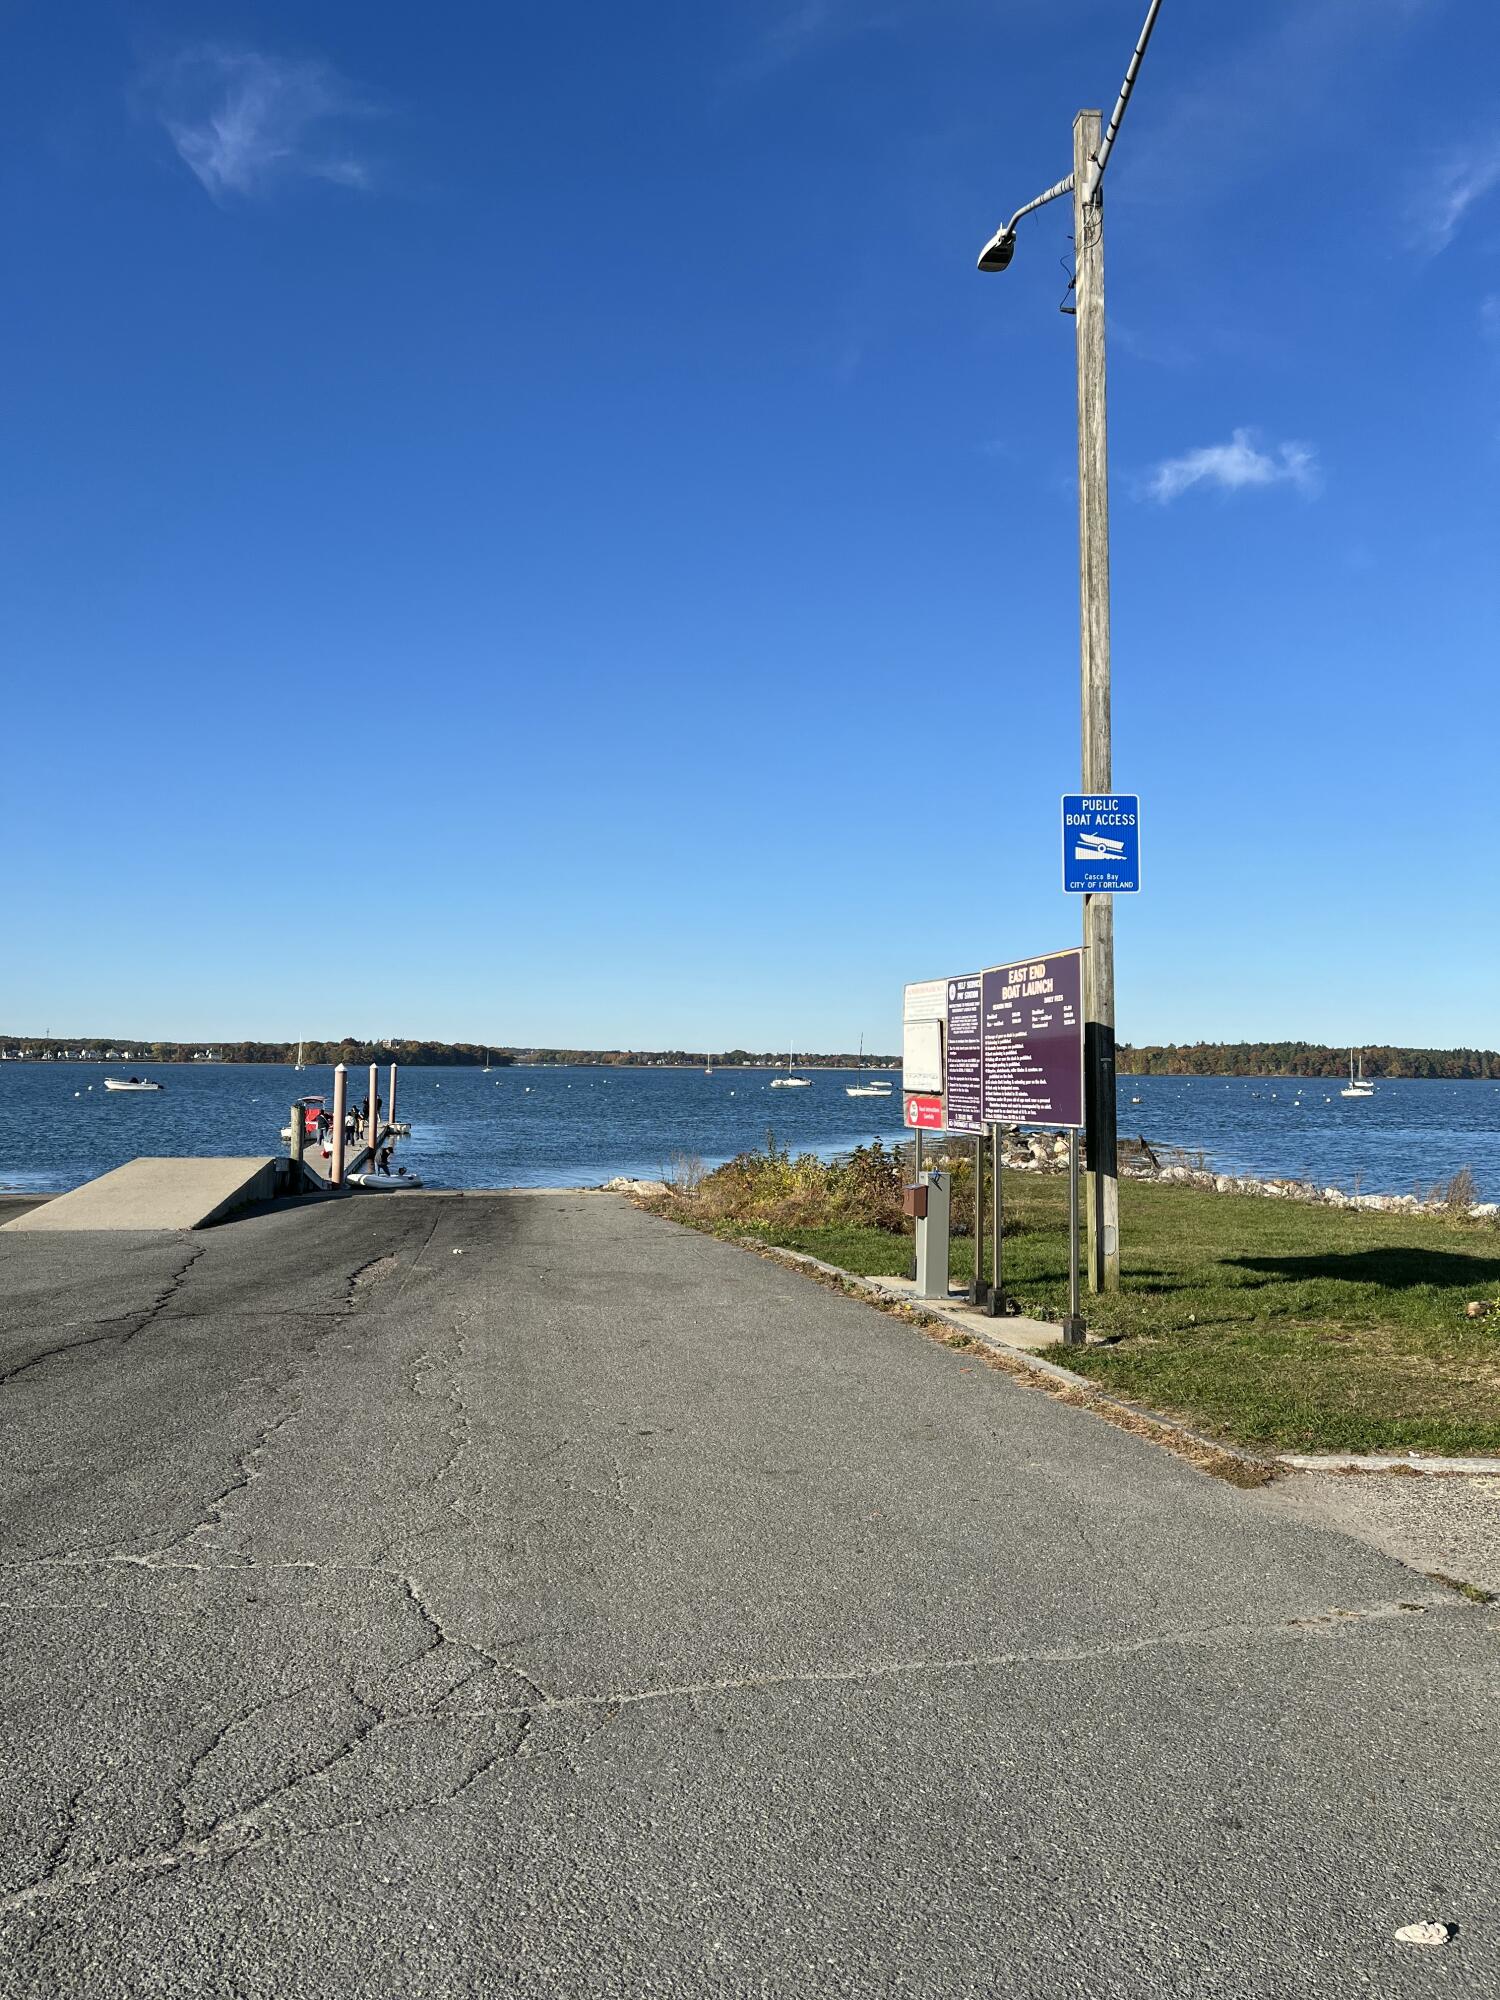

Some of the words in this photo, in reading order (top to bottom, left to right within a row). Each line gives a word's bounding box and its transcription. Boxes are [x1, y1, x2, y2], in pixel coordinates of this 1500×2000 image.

[1082, 799, 1119, 811] PUBLIC
[1066, 814, 1091, 826] BOAT
[1095, 814, 1136, 826] ACCESS
[1084, 873, 1104, 881] Casco
[1106, 873, 1119, 881] Bay
[1070, 881, 1085, 889] CITY
[1087, 881, 1096, 889] OF
[1008, 967, 1028, 984] EAST
[1029, 963, 1046, 980] END
[1002, 984, 1021, 1000] BOAT
[1022, 978, 1054, 997] LAUNCH
